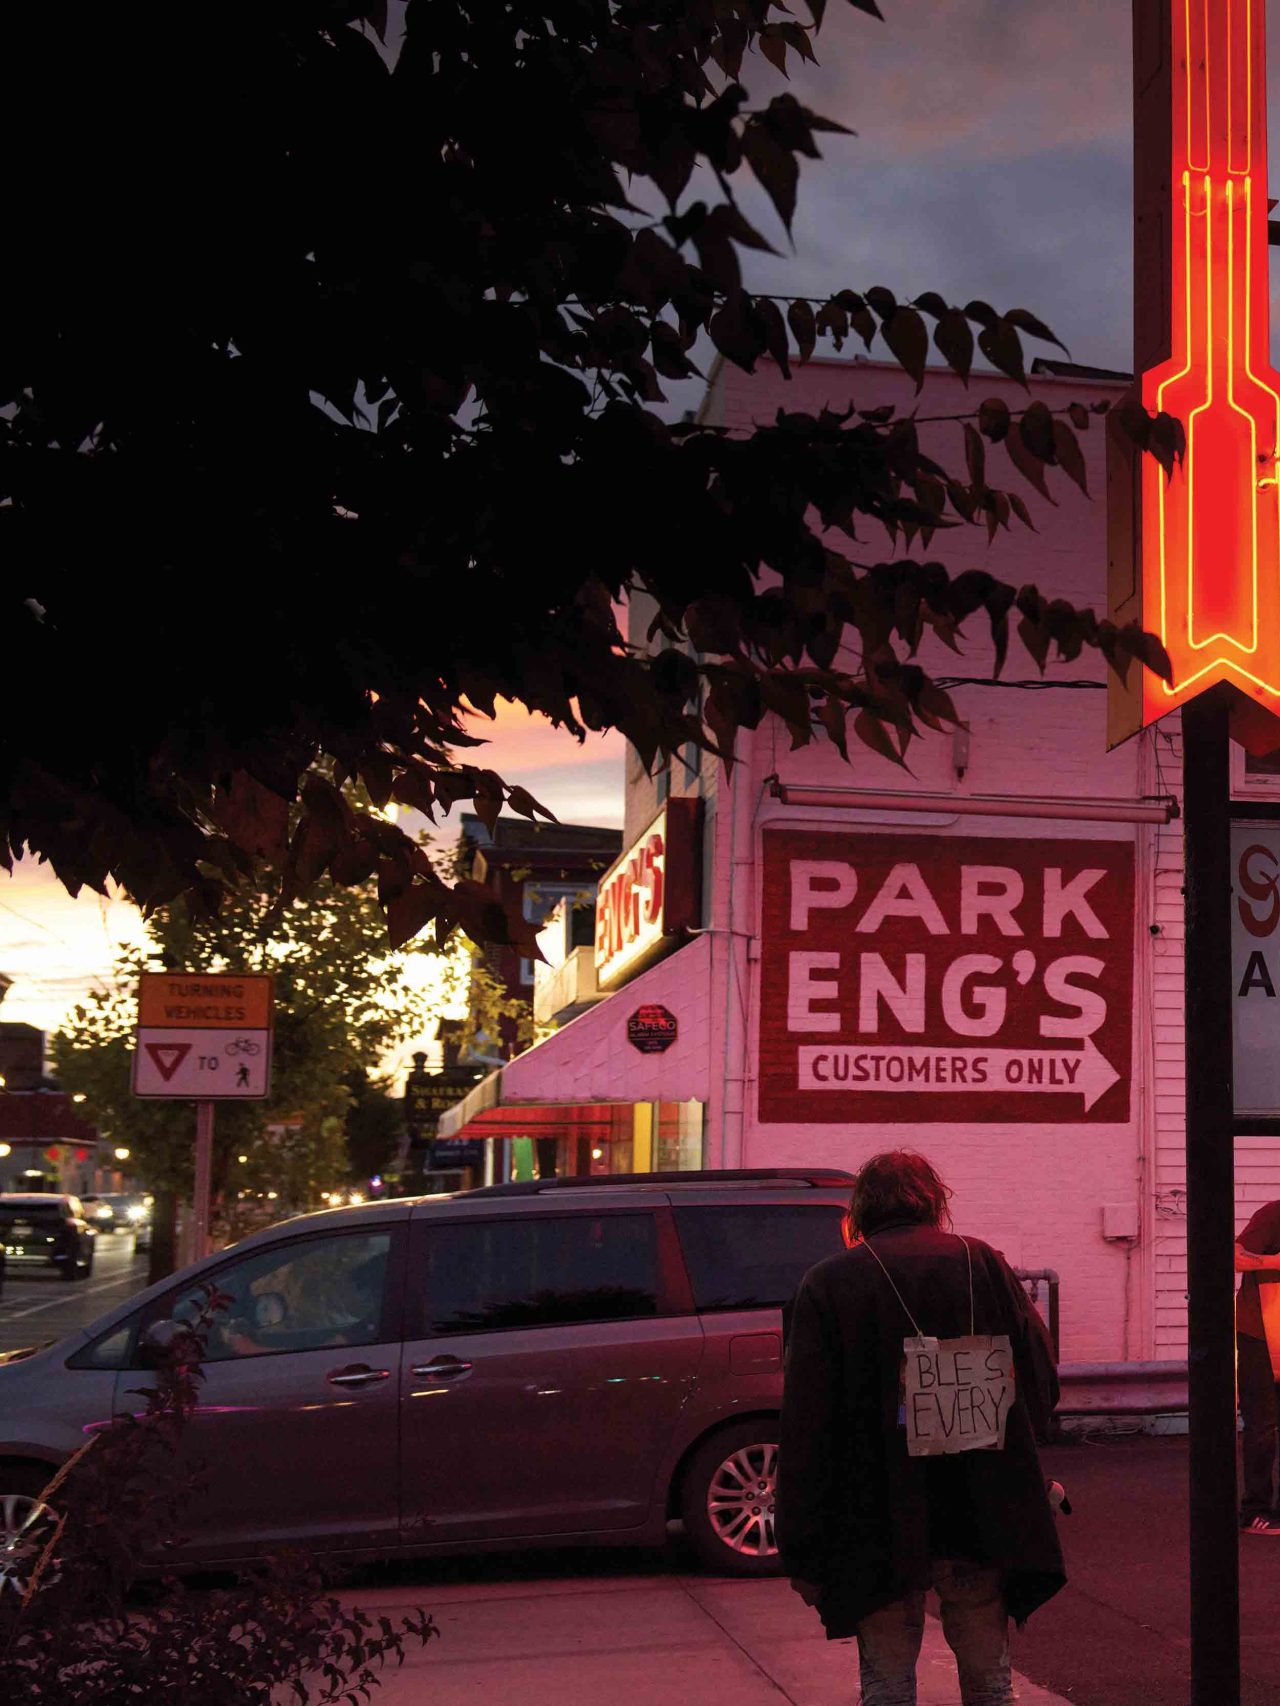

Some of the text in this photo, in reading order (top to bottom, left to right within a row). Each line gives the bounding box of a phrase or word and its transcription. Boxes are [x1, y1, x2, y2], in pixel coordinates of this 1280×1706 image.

[789, 859, 1110, 939] PARK
[167, 983, 245, 998] TURNING
[787, 949, 1107, 1038] ENG'S
[164, 1005, 246, 1020] VEHICLES
[198, 1056, 219, 1071] TO
[811, 1054, 1081, 1084] CUSTOMERS ONLY
[912, 1386, 1006, 1439] EVERY
